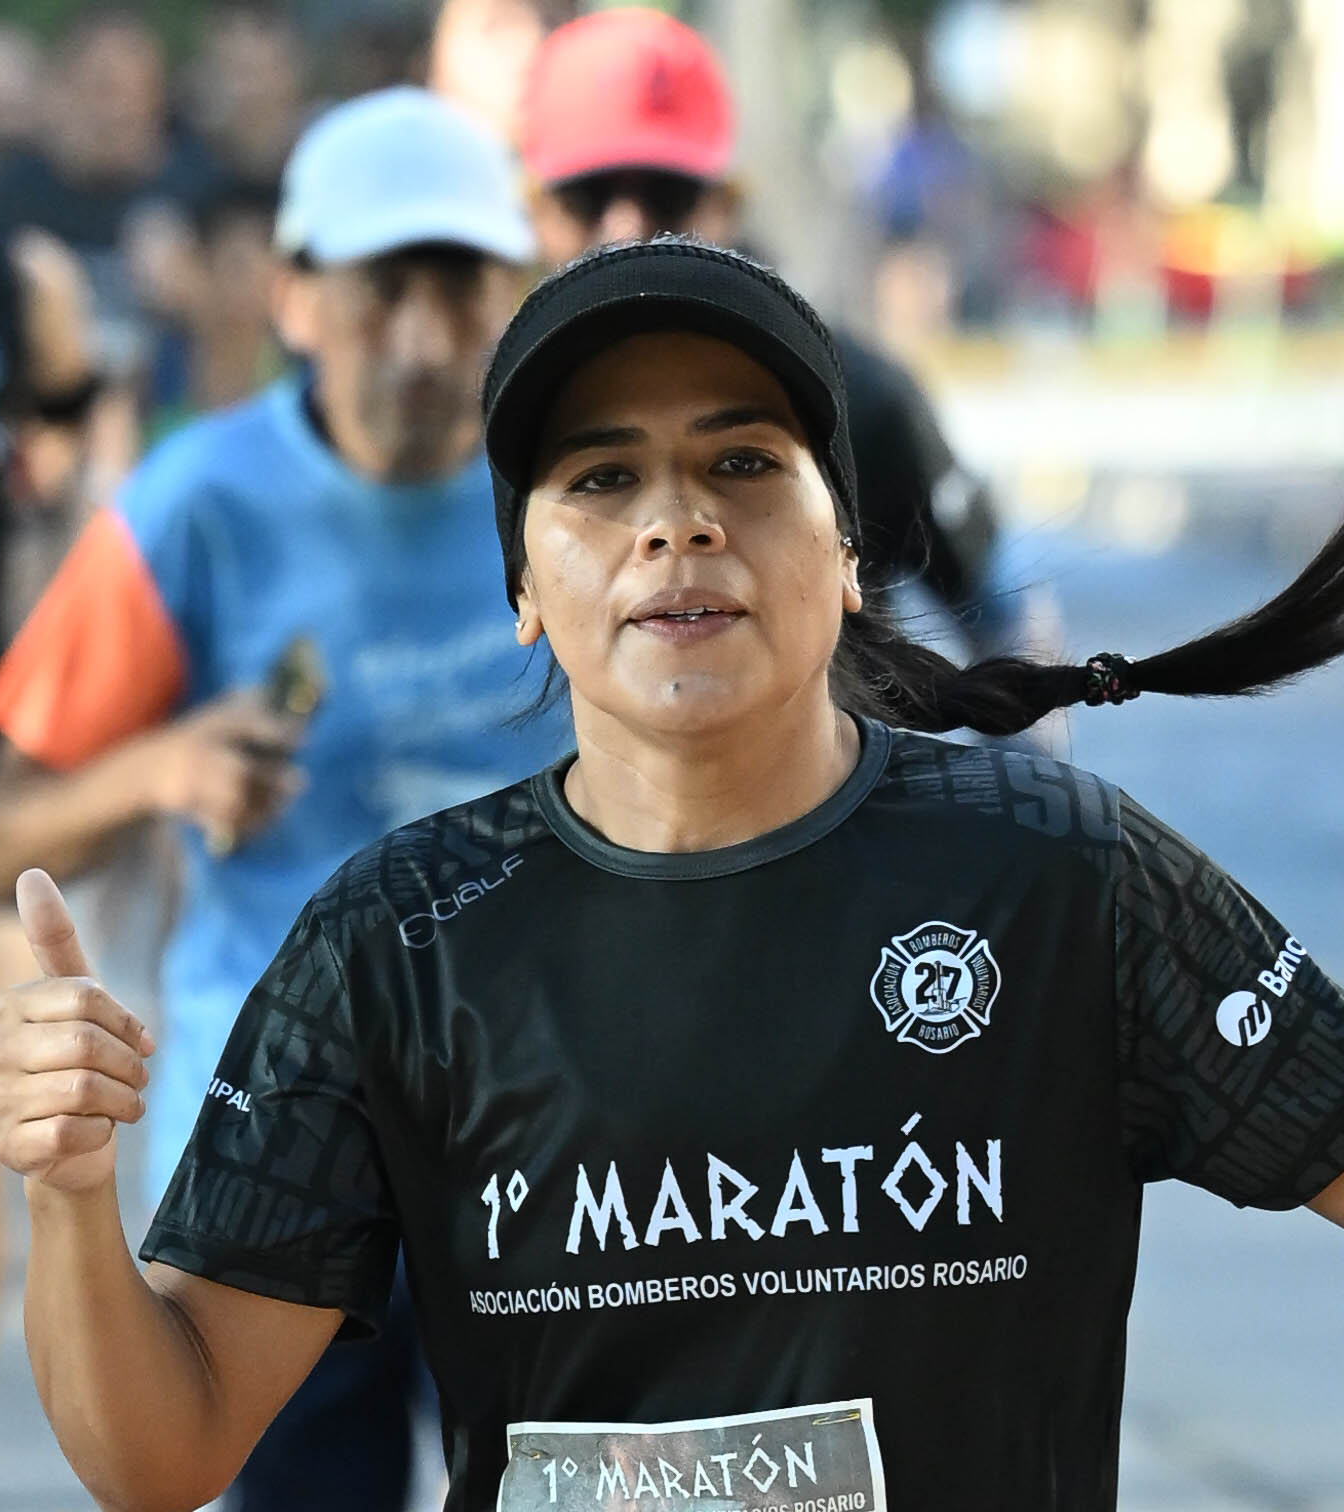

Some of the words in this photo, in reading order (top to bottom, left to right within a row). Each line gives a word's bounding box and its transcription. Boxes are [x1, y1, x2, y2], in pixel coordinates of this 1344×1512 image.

[908, 932, 961, 953] BOMBEROS
[882, 961, 905, 1016] ASOCIACIÓN
[914, 961, 962, 1006] 27
[970, 953, 992, 1011] VOLUNTARIOS
[917, 1022, 960, 1041] ROSARIO
[565, 1111, 1003, 1255] MARATÓN
[469, 1282, 581, 1315] ASOCIACIÓN
[588, 1273, 737, 1309] BOMBEROS
[743, 1262, 925, 1296] VOLUNTARIOS
[932, 1254, 1028, 1288] ROSARIO
[595, 1433, 819, 1502] MARATÓN
